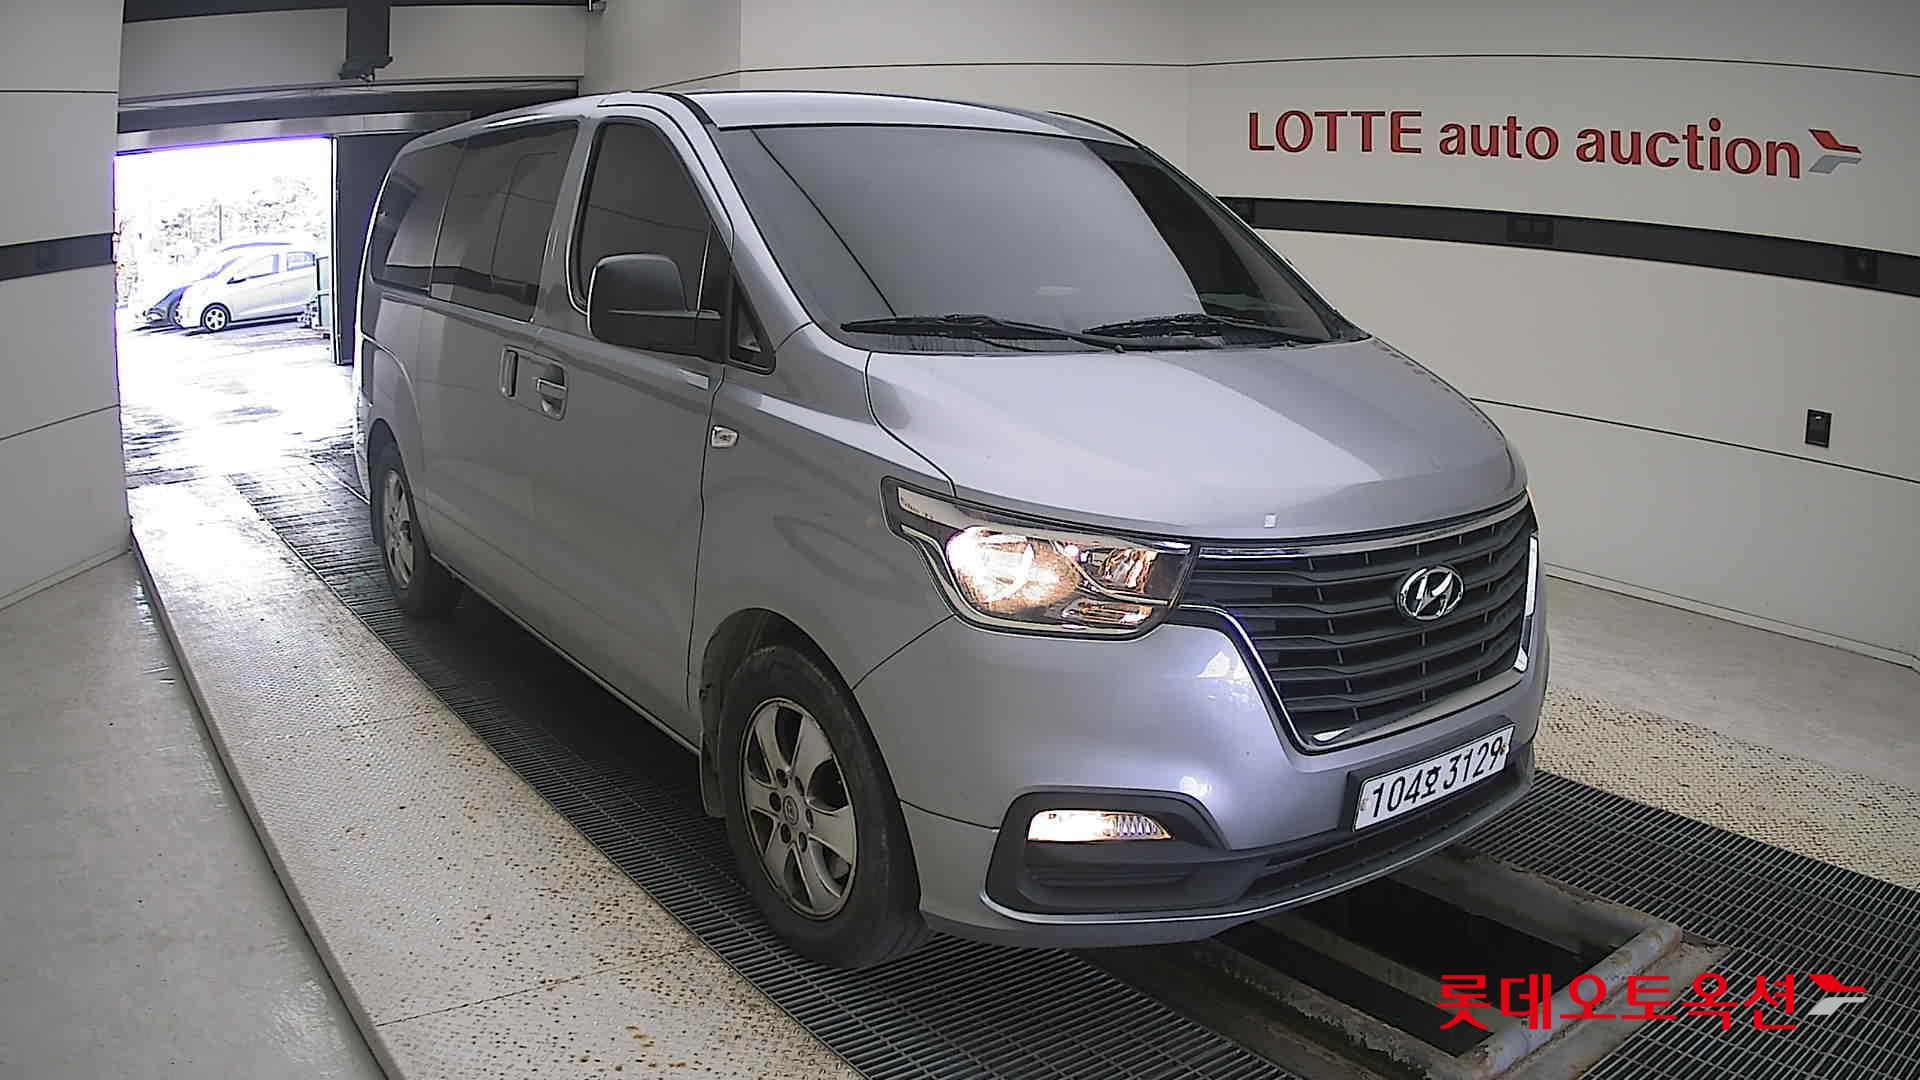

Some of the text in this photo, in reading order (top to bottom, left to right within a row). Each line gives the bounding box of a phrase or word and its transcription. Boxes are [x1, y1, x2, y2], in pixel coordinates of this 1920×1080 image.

[1248, 110, 1801, 179] LOTTE auto auction
